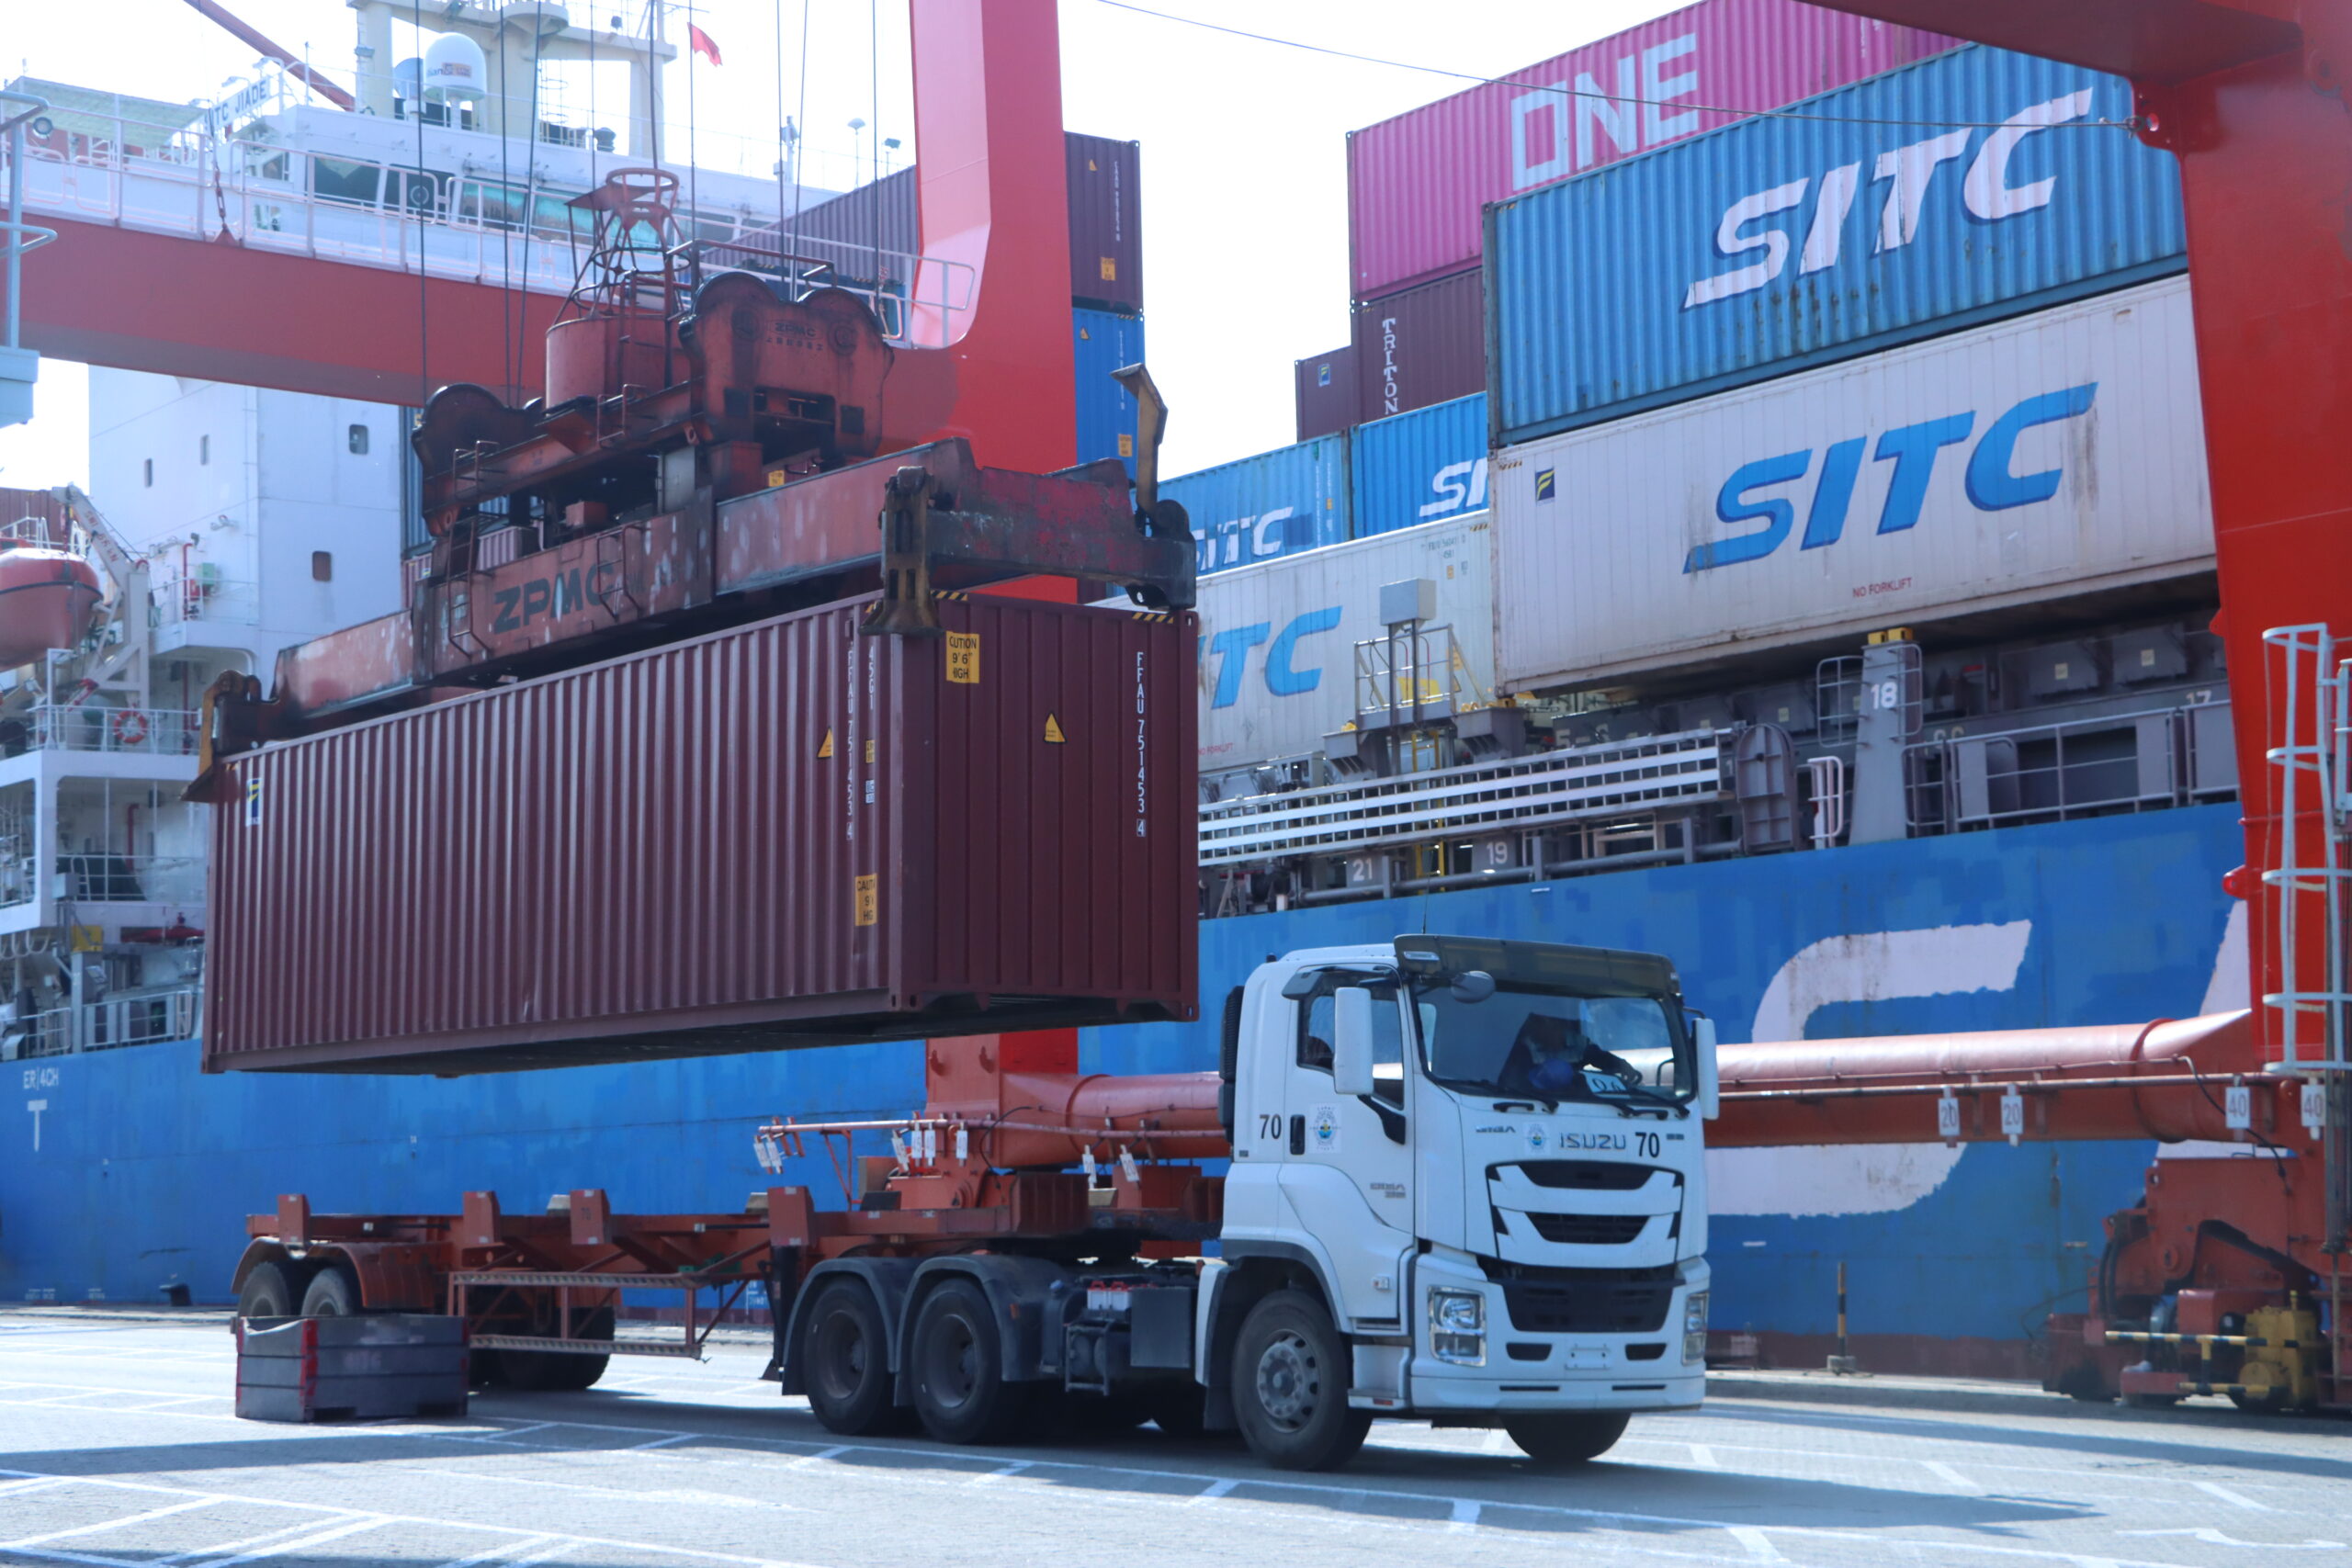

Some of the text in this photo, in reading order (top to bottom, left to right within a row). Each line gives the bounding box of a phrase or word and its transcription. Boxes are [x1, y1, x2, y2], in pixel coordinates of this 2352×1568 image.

[235, 80, 266, 113] JIADE
[1511, 32, 1699, 192] ONE
[1682, 86, 2093, 310] SITC
[1382, 318, 1398, 415] TRITON
[1683, 382, 2098, 573] SITC
[493, 561, 614, 635] ZPMC
[1852, 577, 1912, 598] NO FORKLIFT
[1871, 681, 1898, 709] 18
[1136, 651, 1146, 837] FFAU 751453 4
[1487, 841, 1508, 865] 19
[1352, 858, 1373, 881] 21
[1941, 1104, 1957, 1128] 20
[2004, 1103, 2021, 1125] 20
[2229, 1094, 2247, 1117] 40
[2304, 1094, 2324, 1117] 40
[1260, 1113, 1282, 1139] 70
[1560, 1132, 1626, 1149] ISUZU
[1635, 1132, 1660, 1158] 70
